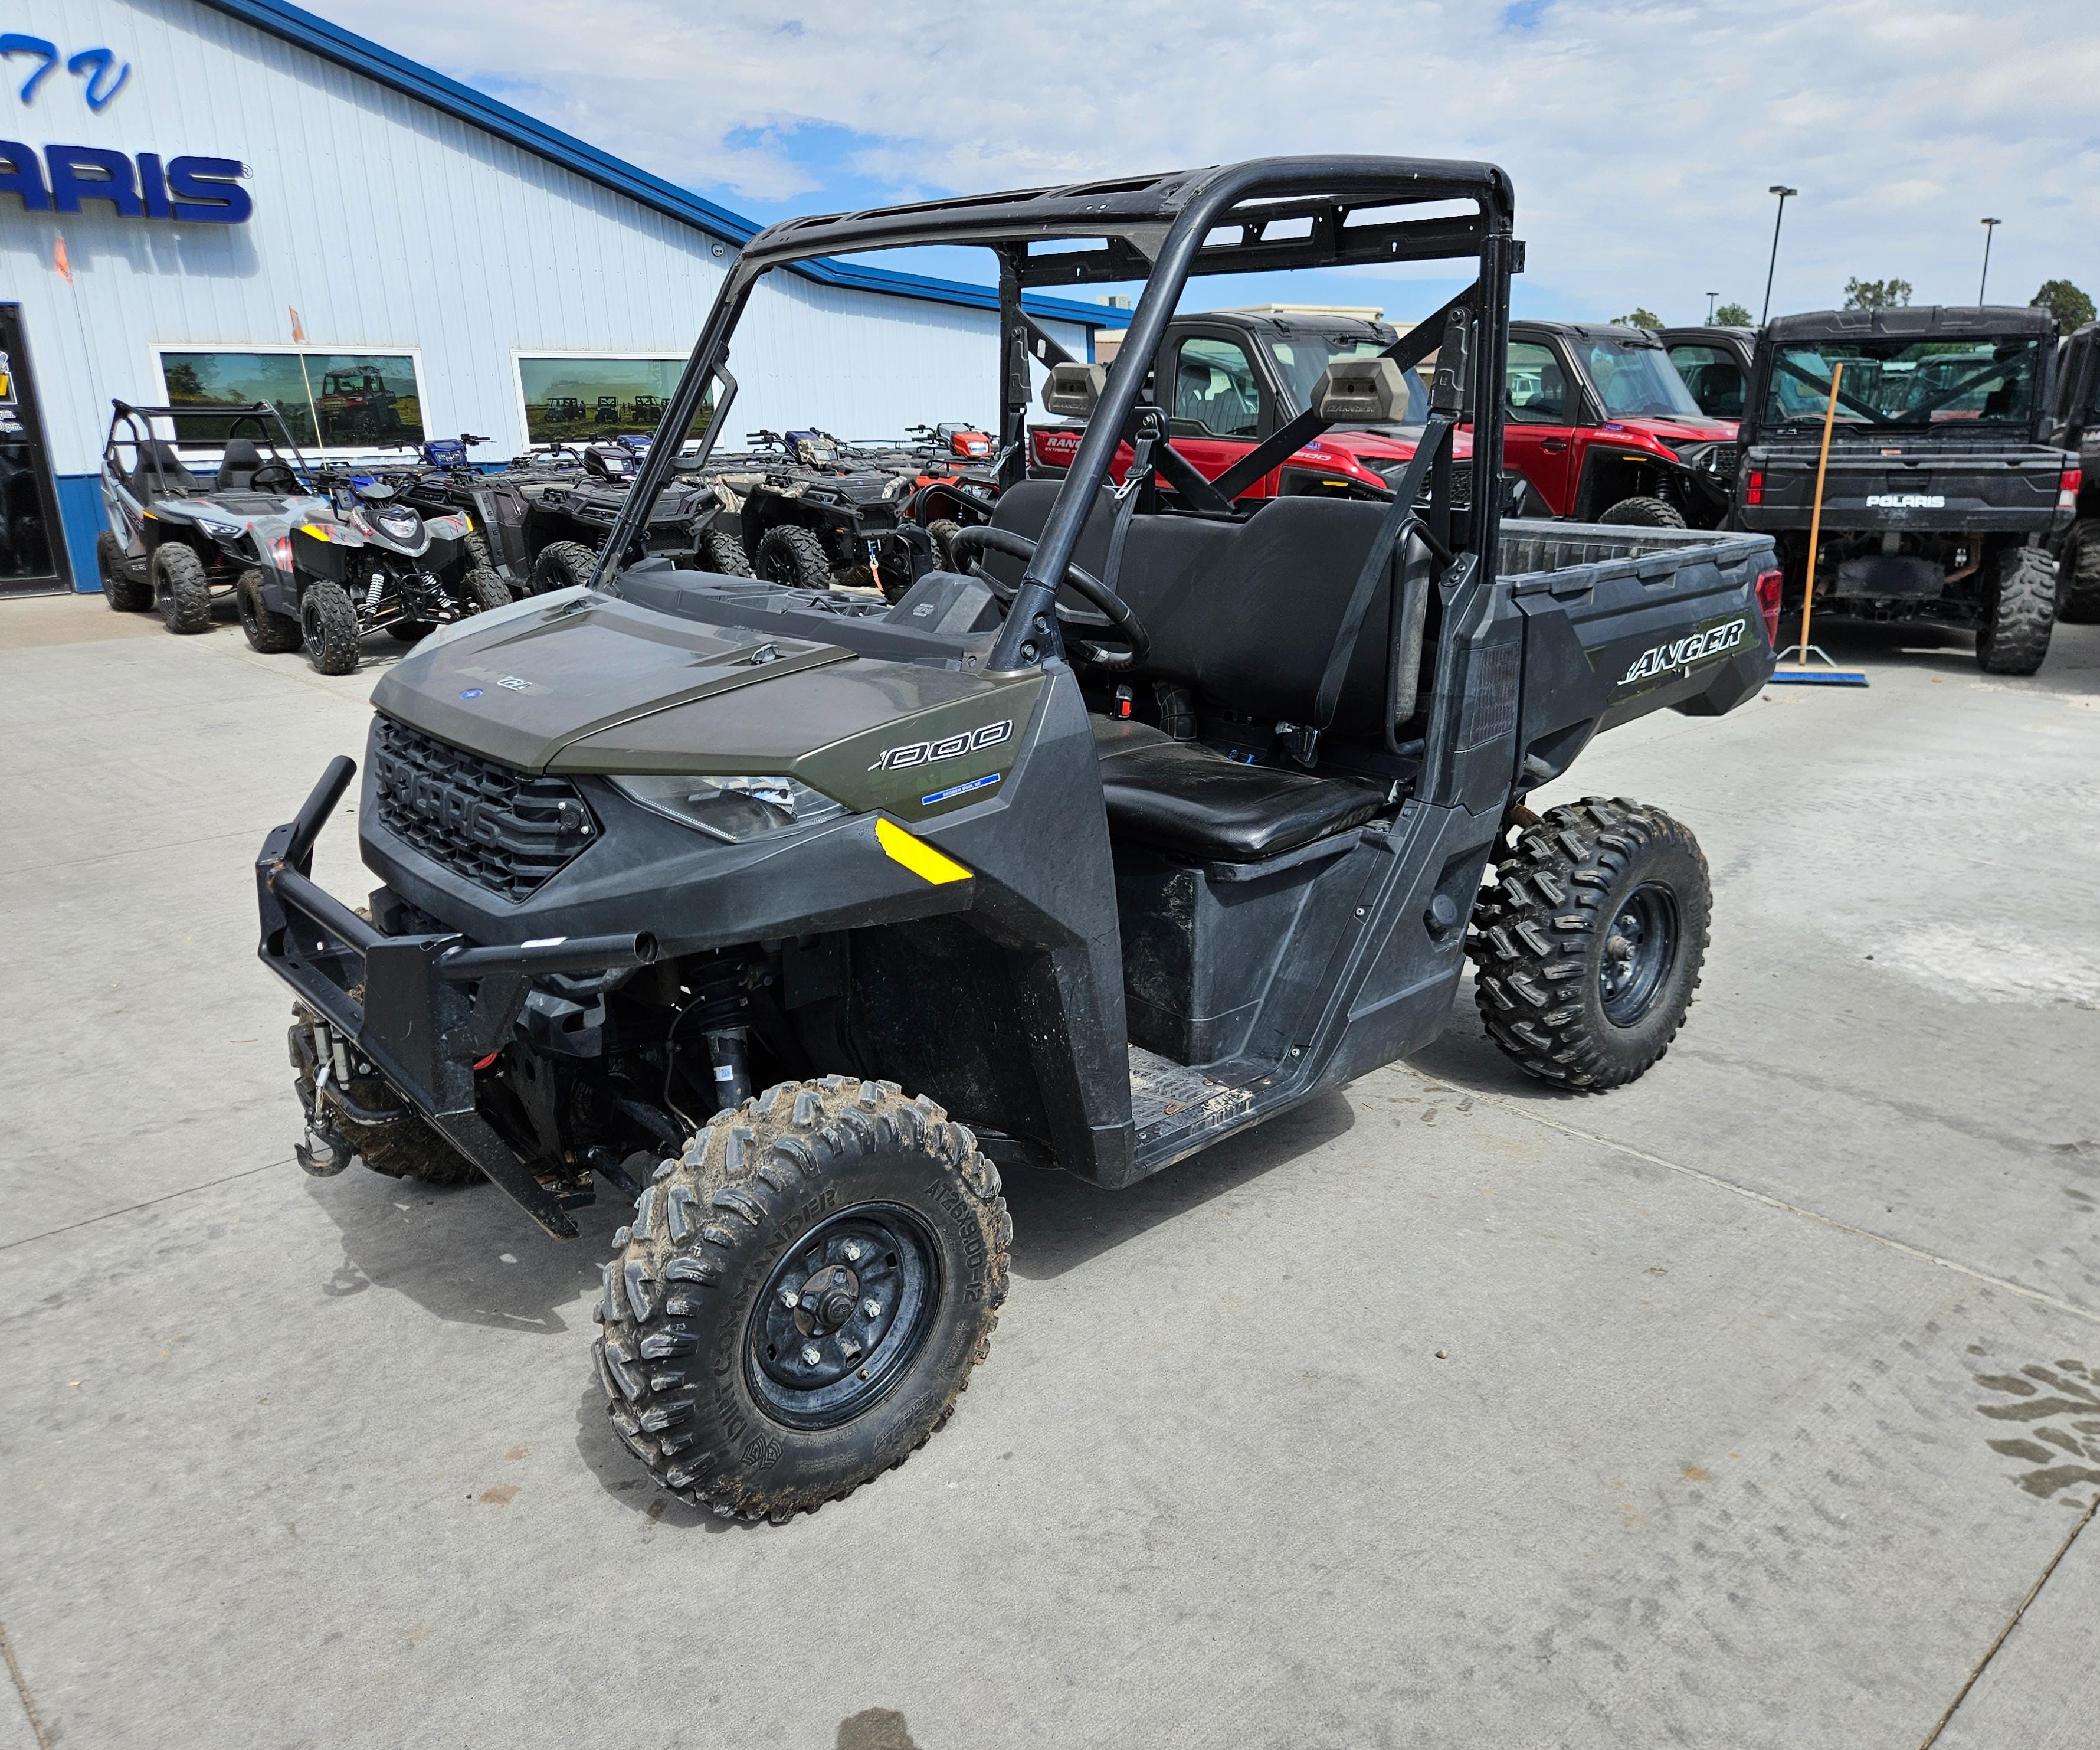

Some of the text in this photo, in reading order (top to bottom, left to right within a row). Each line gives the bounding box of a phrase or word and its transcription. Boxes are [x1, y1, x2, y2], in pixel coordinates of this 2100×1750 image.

[1326, 404, 1376, 413] RANGER
[1866, 495, 1945, 508] POLARIS
[1617, 619, 1746, 686] ANGER
[376, 745, 503, 849] POLARIS
[713, 1188, 836, 1378] COMMANDER
